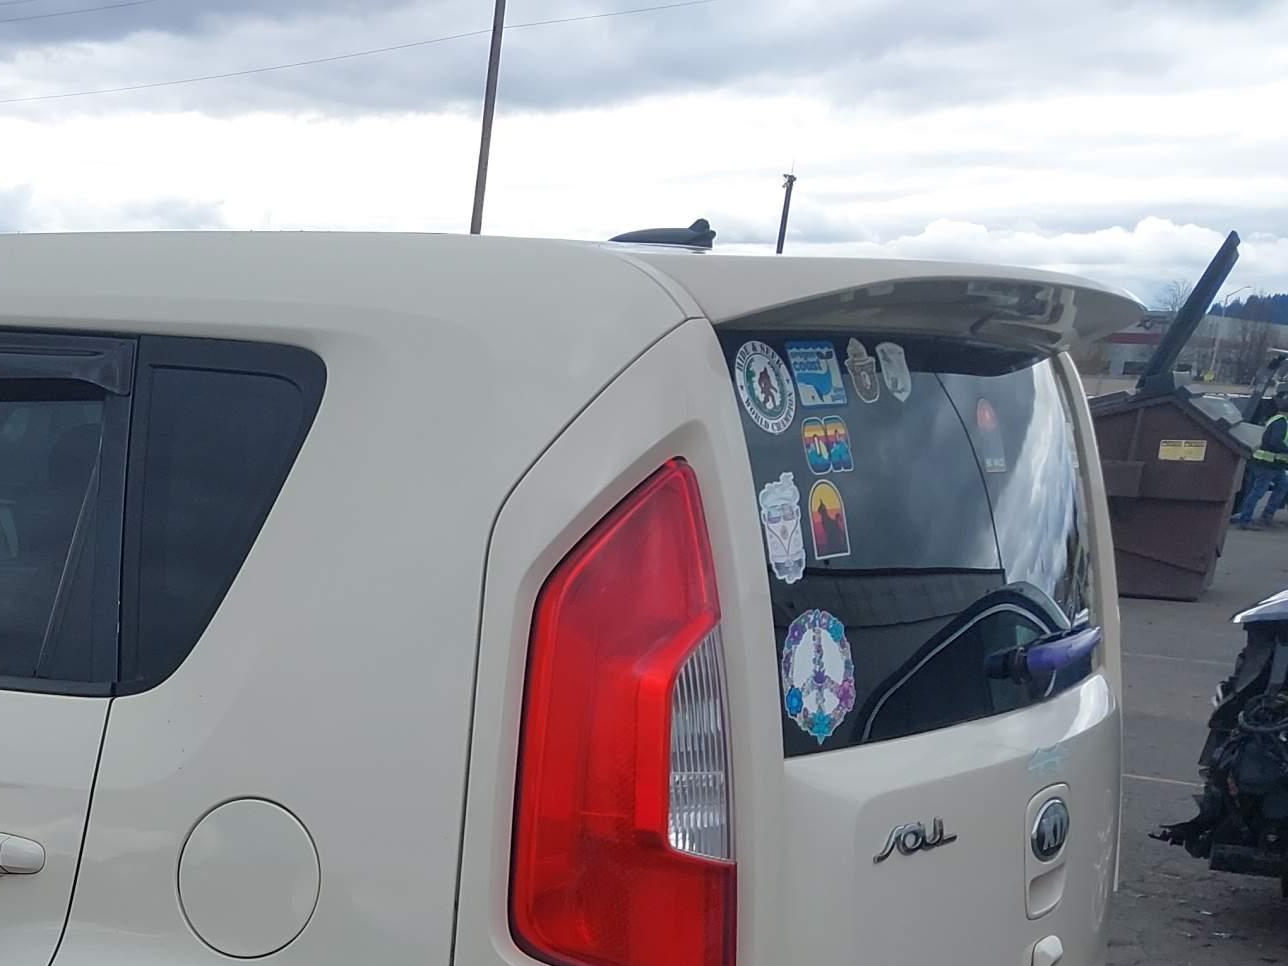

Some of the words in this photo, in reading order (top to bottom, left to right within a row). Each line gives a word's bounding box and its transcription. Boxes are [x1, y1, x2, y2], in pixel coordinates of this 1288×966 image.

[736, 344, 749, 371] HIDE
[745, 397, 770, 430] WORLD
[872, 816, 958, 864] SOUL
